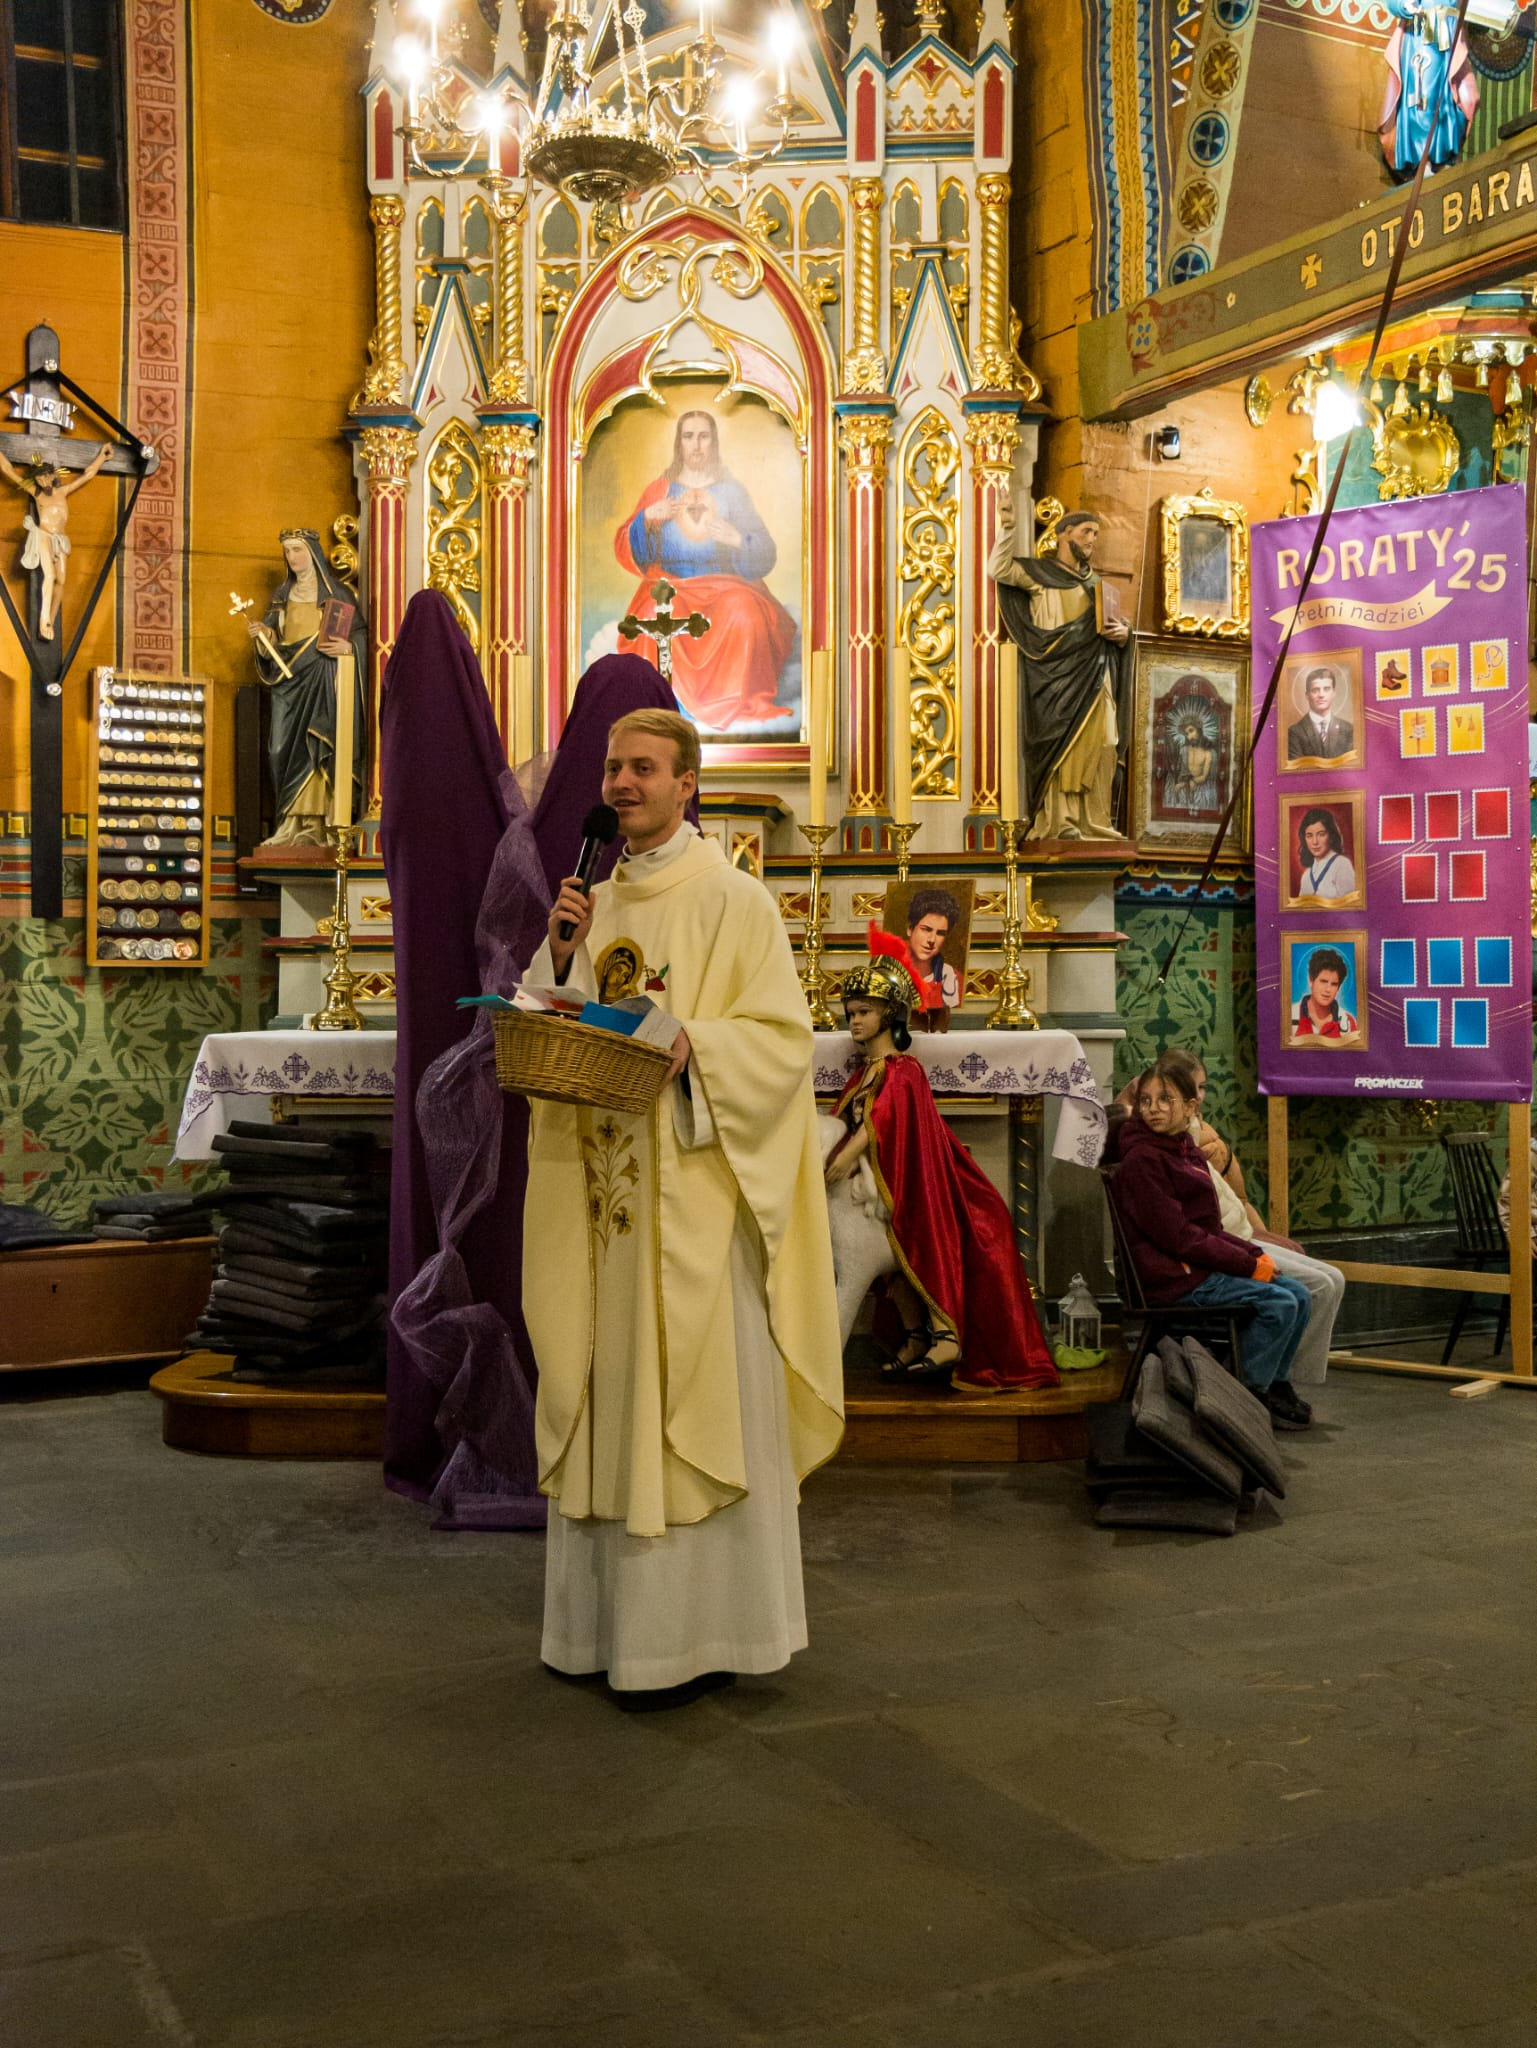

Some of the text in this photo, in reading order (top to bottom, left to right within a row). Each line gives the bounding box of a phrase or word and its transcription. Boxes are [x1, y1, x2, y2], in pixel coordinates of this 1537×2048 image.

[1361, 161, 1534, 268] OTO BARA
[1277, 527, 1454, 590] RORATY
[1297, 602, 1425, 625] pełni nadziei
[1354, 1077, 1424, 1090] PROMYCZEK
